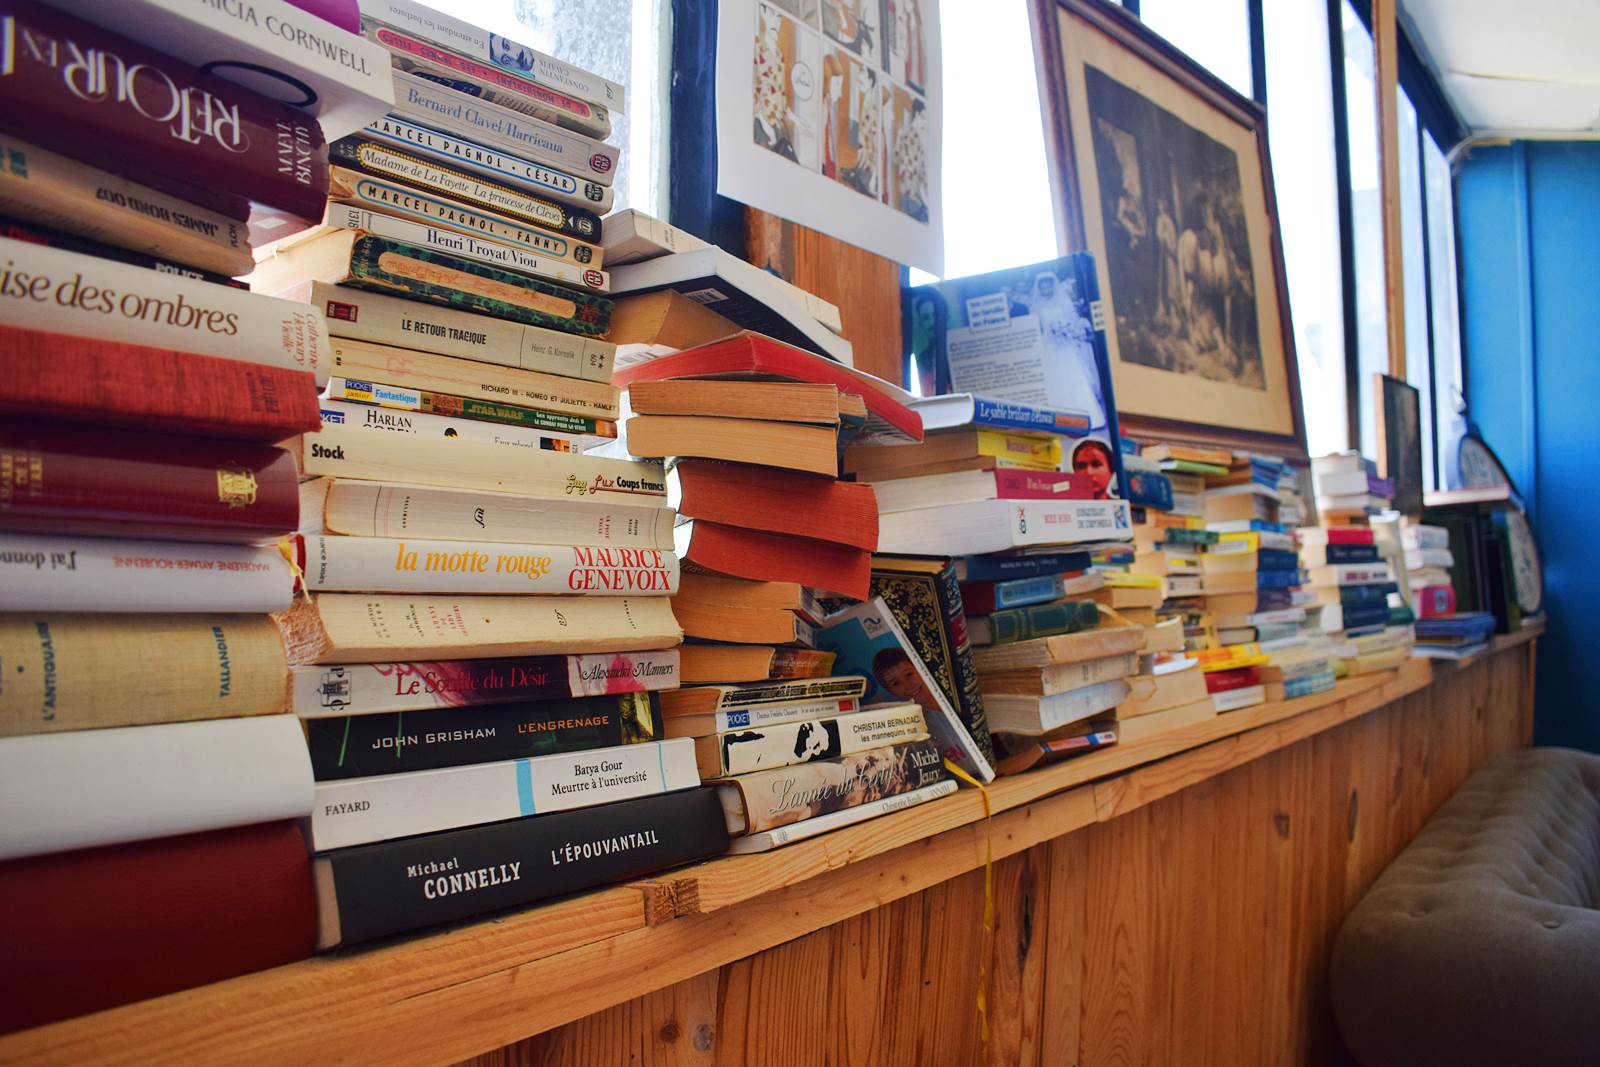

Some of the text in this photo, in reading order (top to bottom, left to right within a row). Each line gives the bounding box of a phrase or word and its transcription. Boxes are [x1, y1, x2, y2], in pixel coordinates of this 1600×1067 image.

[266, 15, 372, 76] CORNWELL
[64, 40, 250, 153] RETOUR
[408, 87, 461, 119] Bernard
[443, 138, 503, 168] PAGNOL
[526, 163, 569, 190] CÉSAR
[363, 149, 561, 222] Madame de La Fayette La princesse de Clèves
[367, 185, 561, 252] MARCEL PAGNOL FANNY
[426, 229, 537, 269] Henri Troyat/Viou
[55, 273, 114, 314] des
[120, 293, 240, 336] ombres
[401, 318, 487, 346] LE RETOUR TRAGIQUE
[375, 388, 418, 404] Fantastique
[481, 383, 510, 396] RICHARD
[366, 410, 412, 428] HARLAN
[312, 443, 345, 461] Stock
[616, 476, 640, 491] Coups
[641, 476, 665, 492] francs
[50, 550, 77, 572] J'ai
[395, 543, 551, 580] la motte rouge
[573, 546, 666, 570] MAURICE
[567, 569, 672, 593] GENEVOIX
[212, 626, 232, 698] TALLANDIER
[395, 672, 420, 696] Le
[509, 666, 549, 690] Désir
[372, 715, 610, 749] JOHN GRISHAM L'ENGRENAGE
[853, 720, 886, 734] CHRISTIAN
[861, 732, 870, 743] les
[574, 760, 624, 776] Batya Gour
[912, 748, 939, 768] Michel
[551, 770, 648, 796] Meurtre à l'université
[325, 800, 371, 816] FAYARD
[551, 829, 660, 866] L'ÉPOUVANTAIL
[407, 858, 460, 878] Michael
[424, 861, 522, 900] CONNELLY
